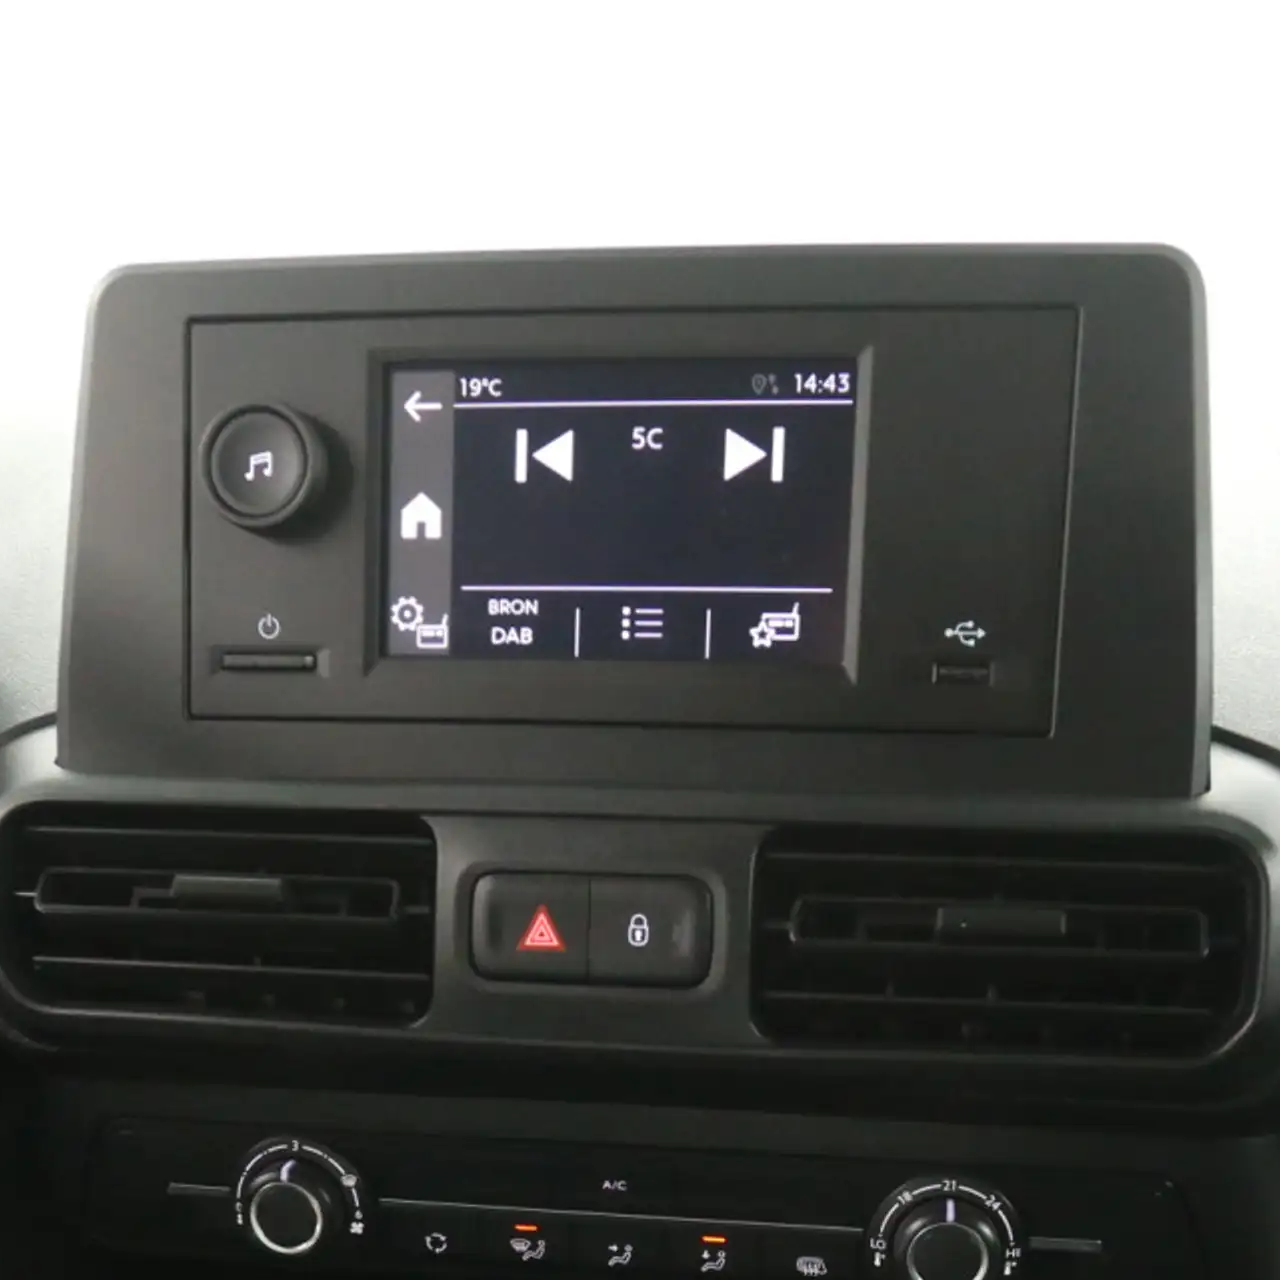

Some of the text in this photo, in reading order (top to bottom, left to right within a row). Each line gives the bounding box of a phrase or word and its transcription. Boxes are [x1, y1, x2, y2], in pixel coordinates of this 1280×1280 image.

[794, 372, 851, 394] 14:43
[631, 426, 664, 450] 5C
[488, 599, 539, 616] BRON
[491, 626, 533, 645] DAB
[602, 1180, 627, 1191] A/C
[941, 1179, 958, 1192] 21
[870, 1237, 887, 1250] LO
